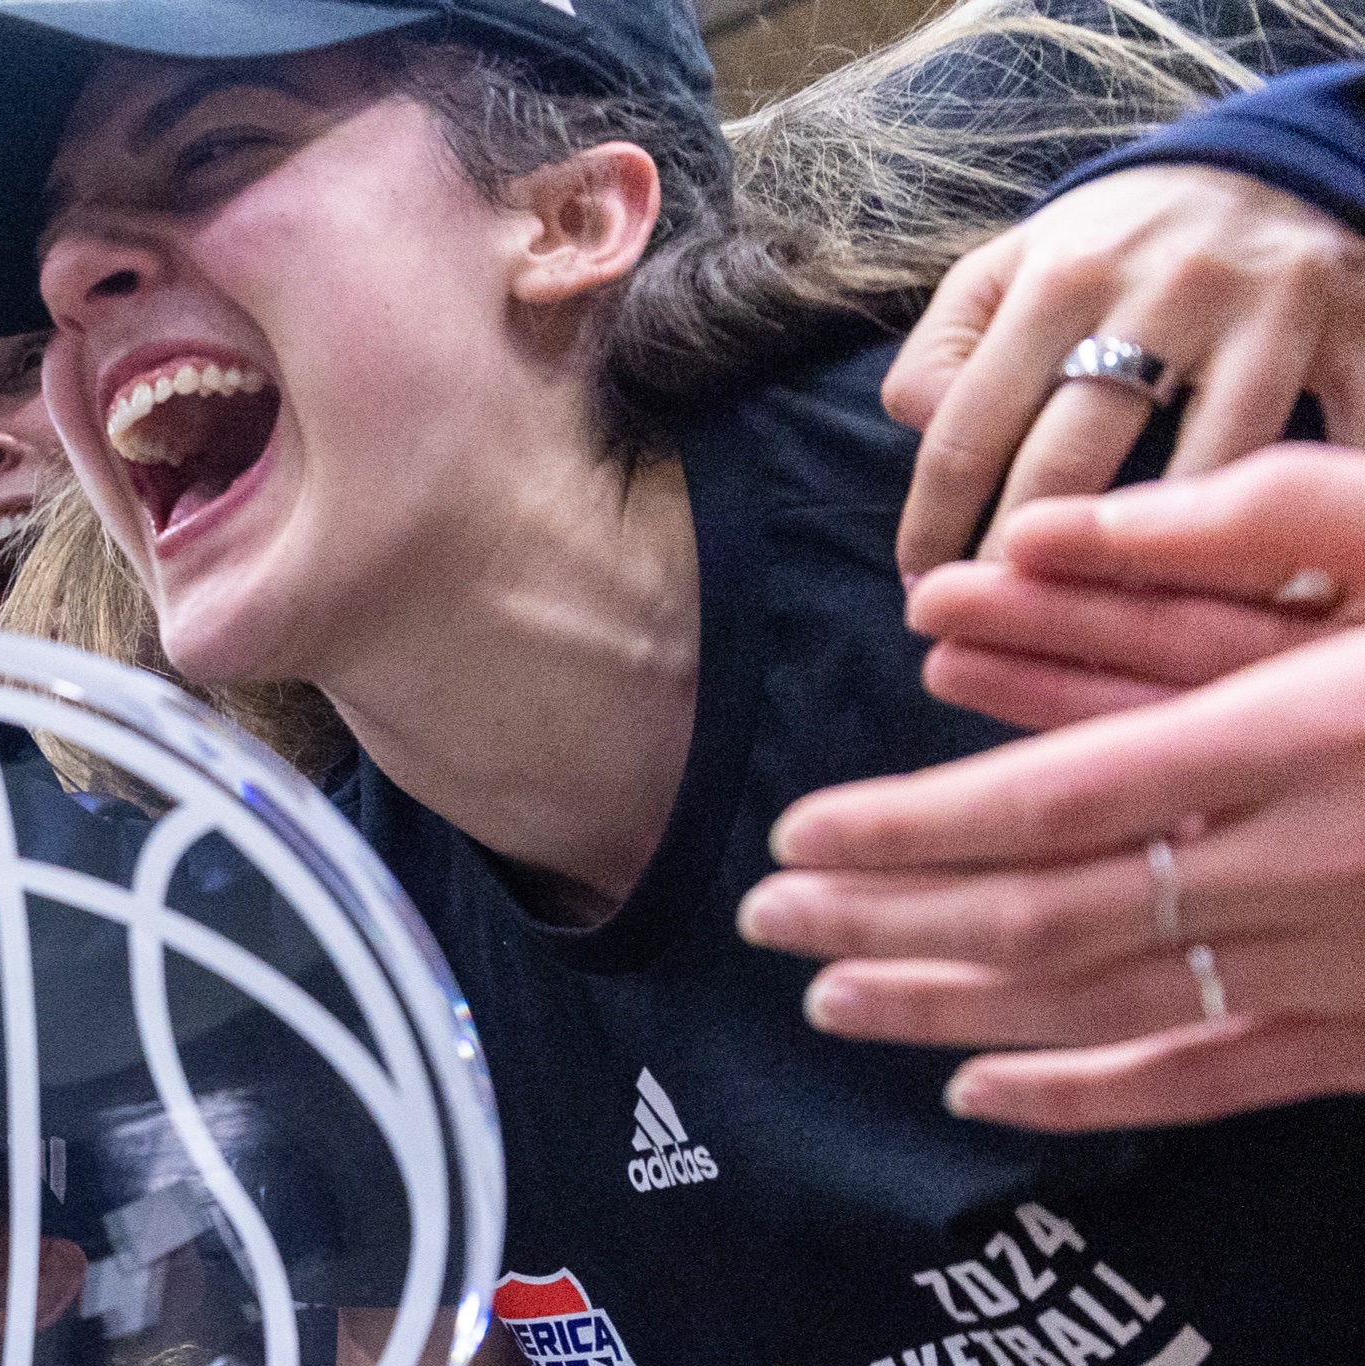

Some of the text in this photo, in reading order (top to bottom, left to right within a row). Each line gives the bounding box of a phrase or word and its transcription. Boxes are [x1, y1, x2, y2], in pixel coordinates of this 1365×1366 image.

[627, 1142, 719, 1193] adidas
[914, 1200, 1087, 1324] 2024
[509, 1314, 624, 1362] ERICA
